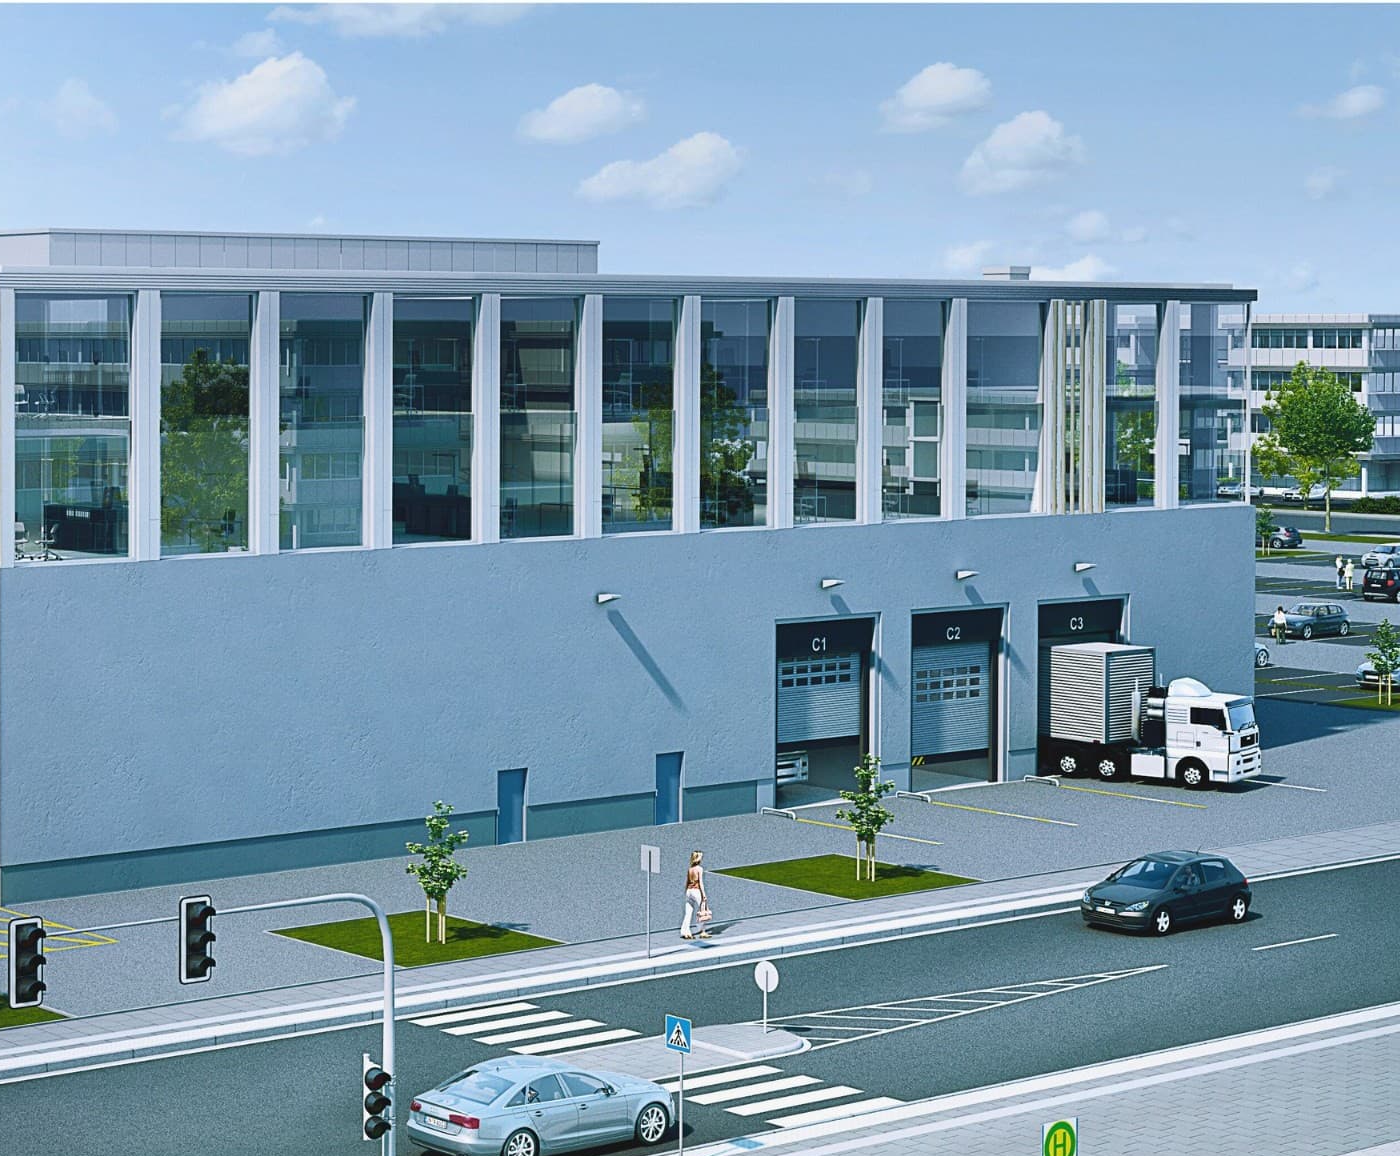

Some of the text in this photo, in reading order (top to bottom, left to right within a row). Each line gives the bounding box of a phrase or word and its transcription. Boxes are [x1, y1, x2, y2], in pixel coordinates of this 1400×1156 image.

[1070, 617, 1084, 630] C3
[946, 627, 961, 641] C2
[812, 637, 826, 652] C1
